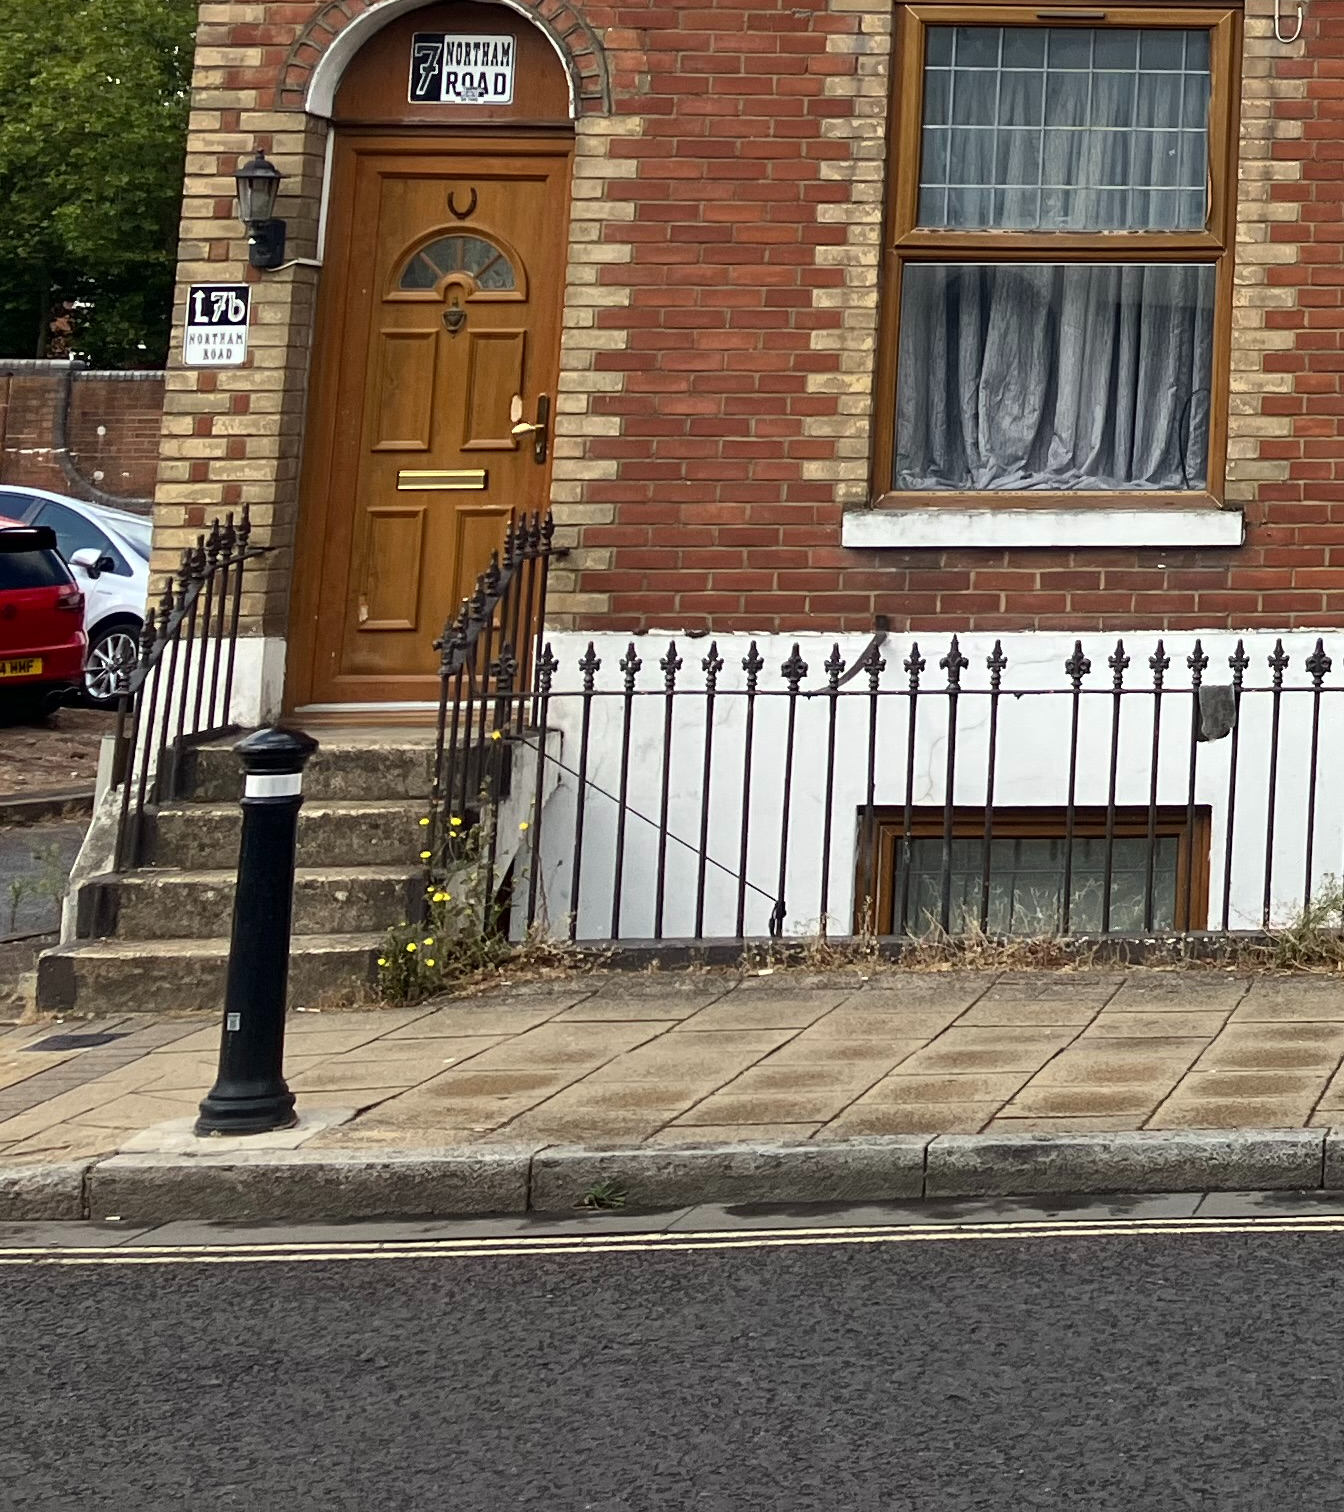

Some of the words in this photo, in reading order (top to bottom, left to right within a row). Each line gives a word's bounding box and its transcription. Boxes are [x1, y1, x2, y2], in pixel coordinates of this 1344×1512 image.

[445, 41, 511, 67] NORTHAM
[414, 42, 443, 96] 7
[445, 71, 507, 97] ROAD
[188, 332, 244, 345] NORTHAM
[202, 348, 233, 361] ROAD
